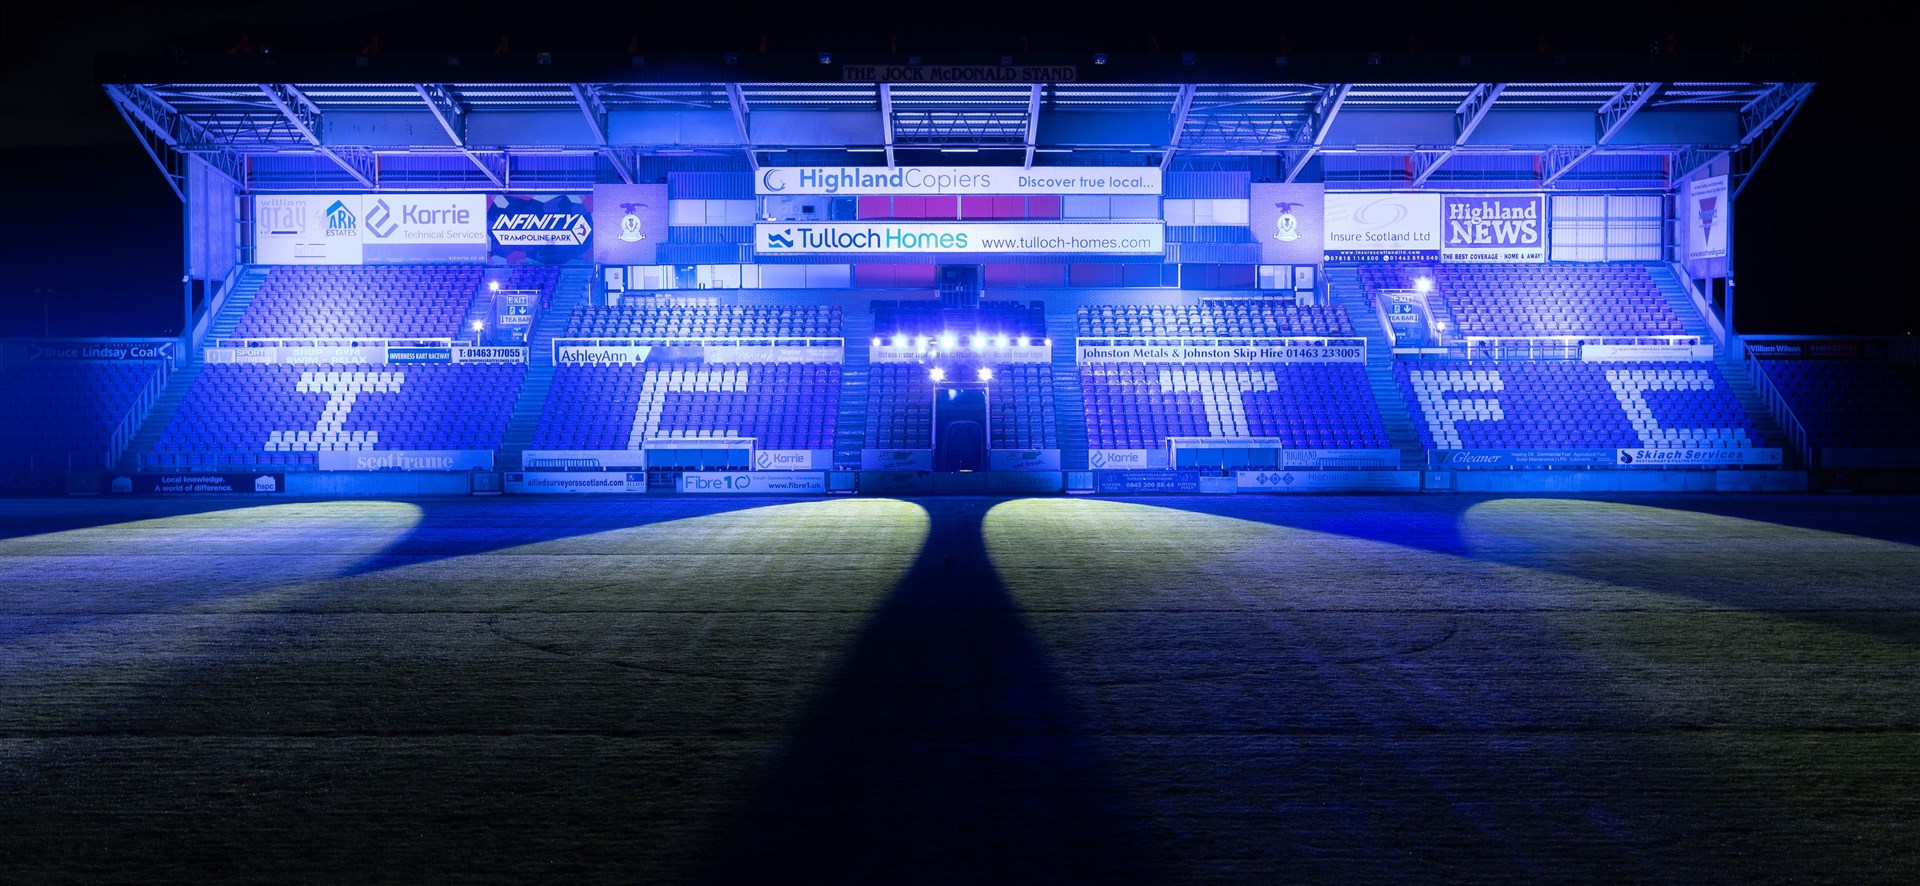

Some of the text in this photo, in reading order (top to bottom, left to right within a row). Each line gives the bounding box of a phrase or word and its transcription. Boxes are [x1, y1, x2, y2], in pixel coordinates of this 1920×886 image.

[844, 67, 1074, 80] THE JOCK McDONALD STAND
[1018, 176, 1154, 188] Discover true local...
[402, 204, 470, 225] Korrie
[1449, 200, 1537, 225] Highland
[260, 206, 306, 234] gray
[492, 213, 580, 230] INFINITY
[404, 230, 484, 239] Technical Services
[1330, 231, 1430, 241] Insure Scotland Ltd
[1450, 219, 1538, 244] NEWS
[797, 228, 1151, 249] Tulloch Homes www.tulloch-homes.com
[44, 347, 157, 360] Bruce Lindsay Coal
[459, 349, 520, 357] T: 01463 717055
[1082, 348, 1360, 360] Johnston Metals & Johnston Skip Hire 01463 233005
[774, 453, 804, 463] Korrie
[1107, 453, 1139, 462] Korrie
[1284, 450, 1317, 462] HIGHLAND
[1452, 452, 1502, 463] Gleaner
[1636, 450, 1744, 459] Skiach Services
[183, 476, 226, 484] knowledge.
[1308, 473, 1349, 481] Highland
[256, 482, 274, 491] hspc
[527, 478, 624, 488] alliedsurveyorsscotland.com
[768, 481, 822, 489] www.fibre1.uk
